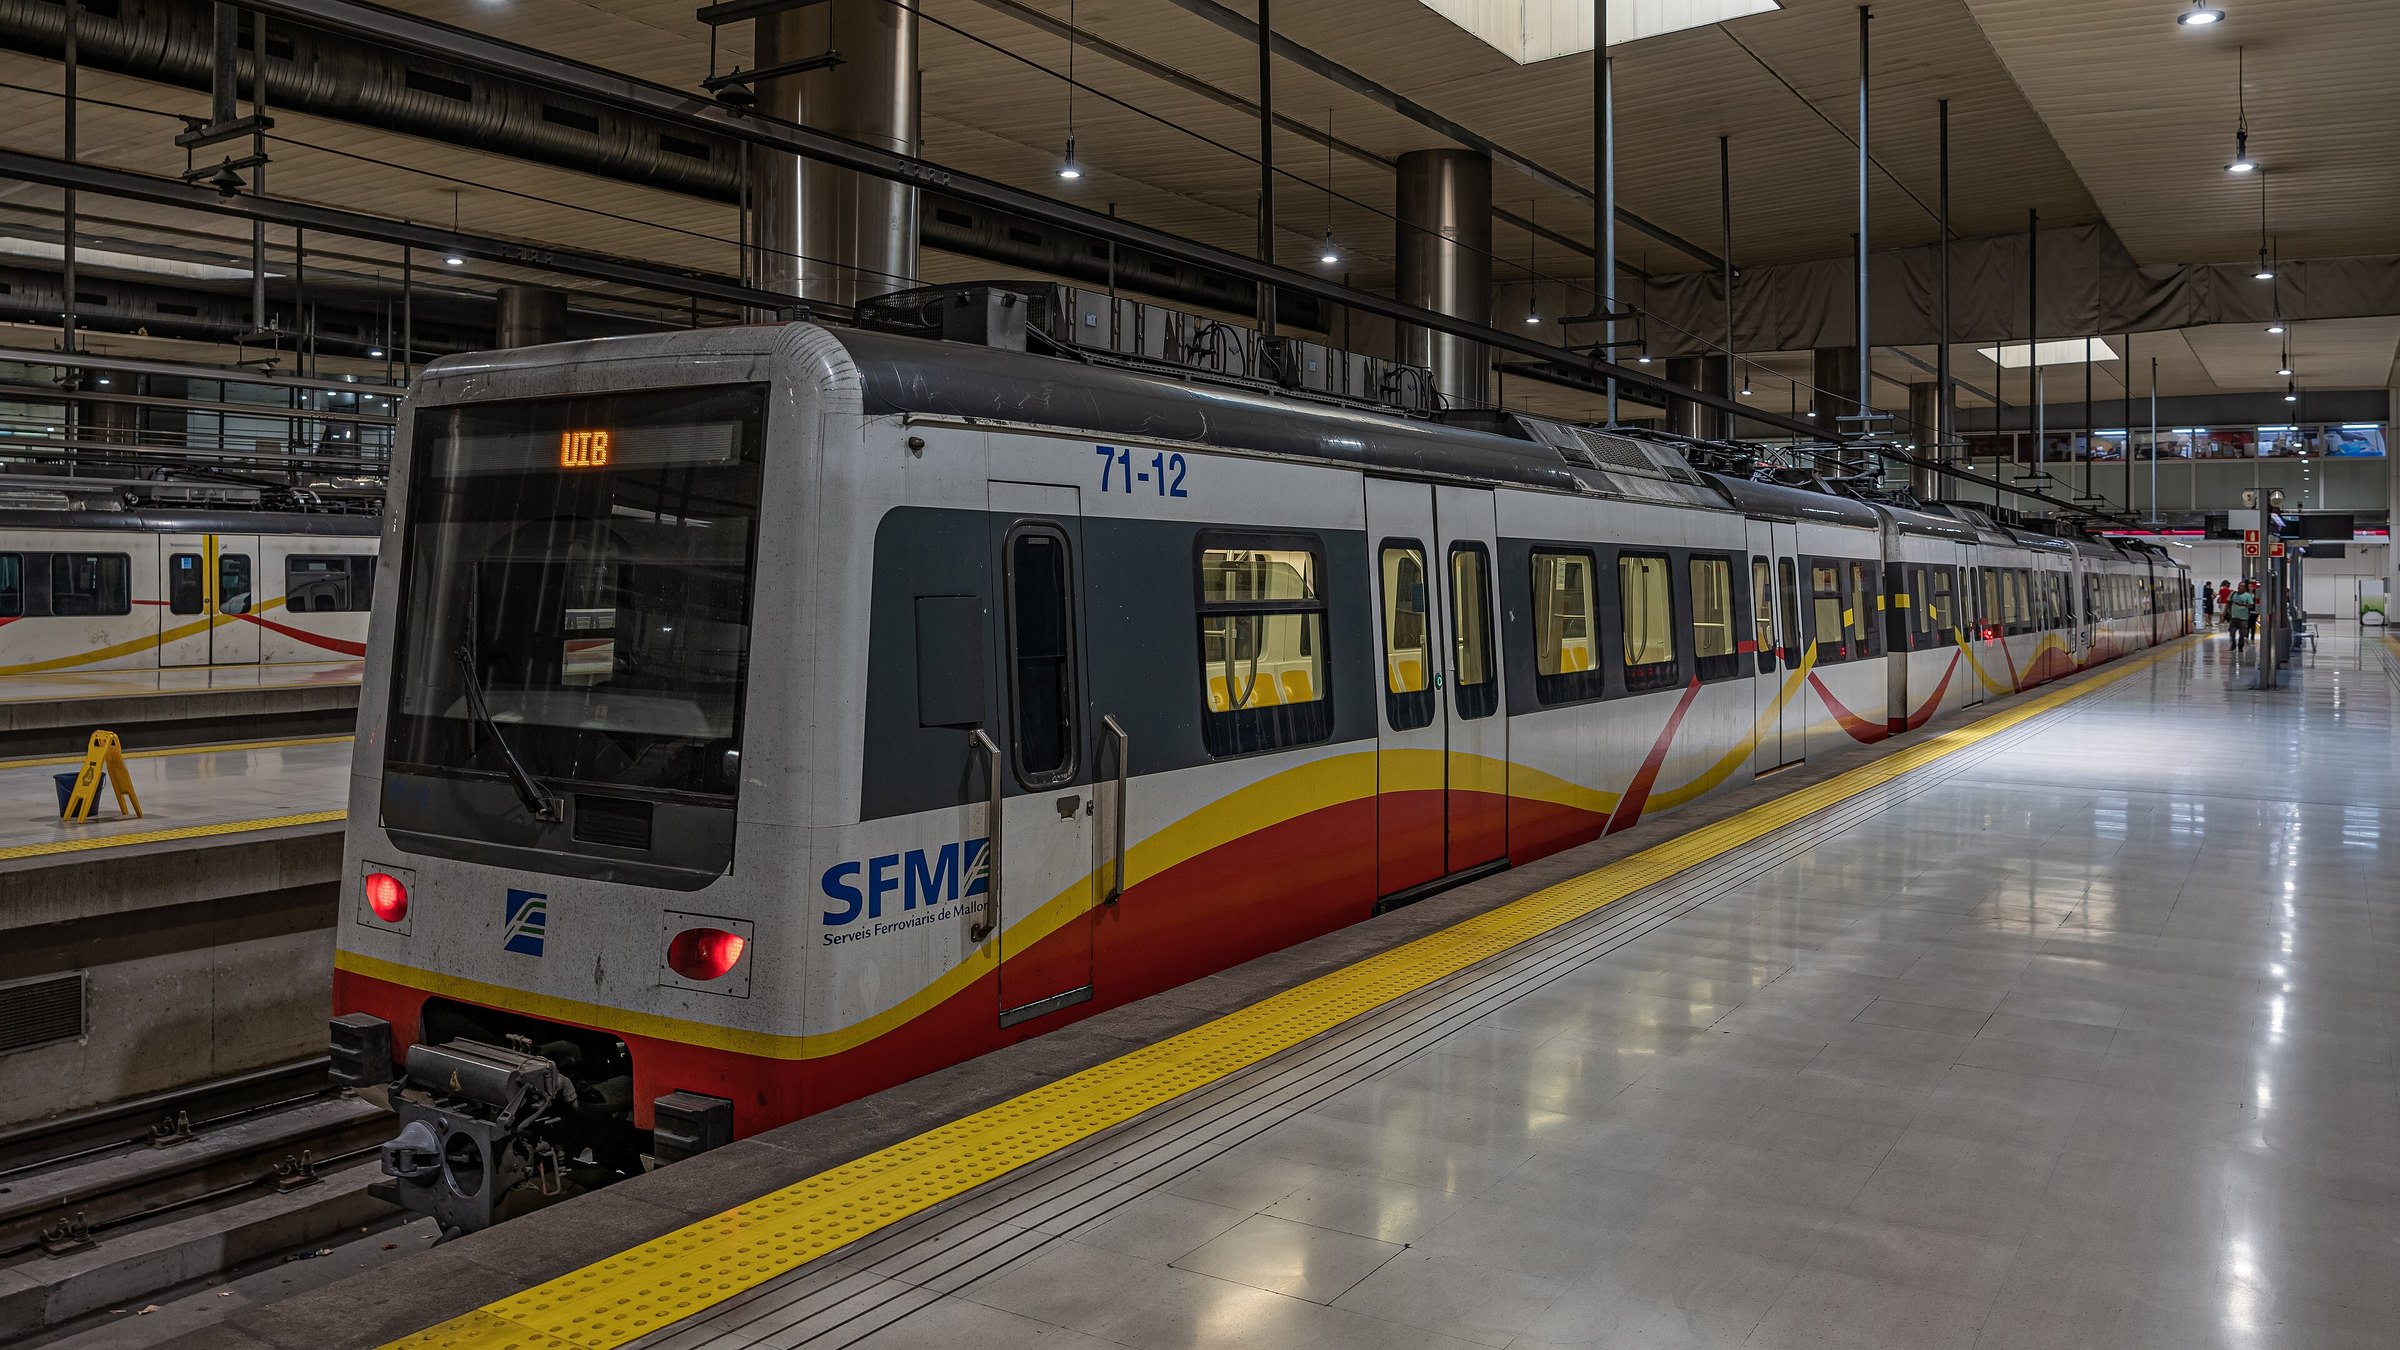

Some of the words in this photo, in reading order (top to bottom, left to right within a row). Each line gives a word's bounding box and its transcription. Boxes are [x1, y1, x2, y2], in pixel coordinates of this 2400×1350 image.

[561, 431, 609, 467] UIB
[1096, 445, 1188, 498] 71-12
[821, 842, 960, 926] SFM
[823, 926, 872, 946] Serveis
[874, 911, 936, 936] Ferroviaris
[938, 908, 951, 921] de
[953, 900, 989, 918] Mallor
